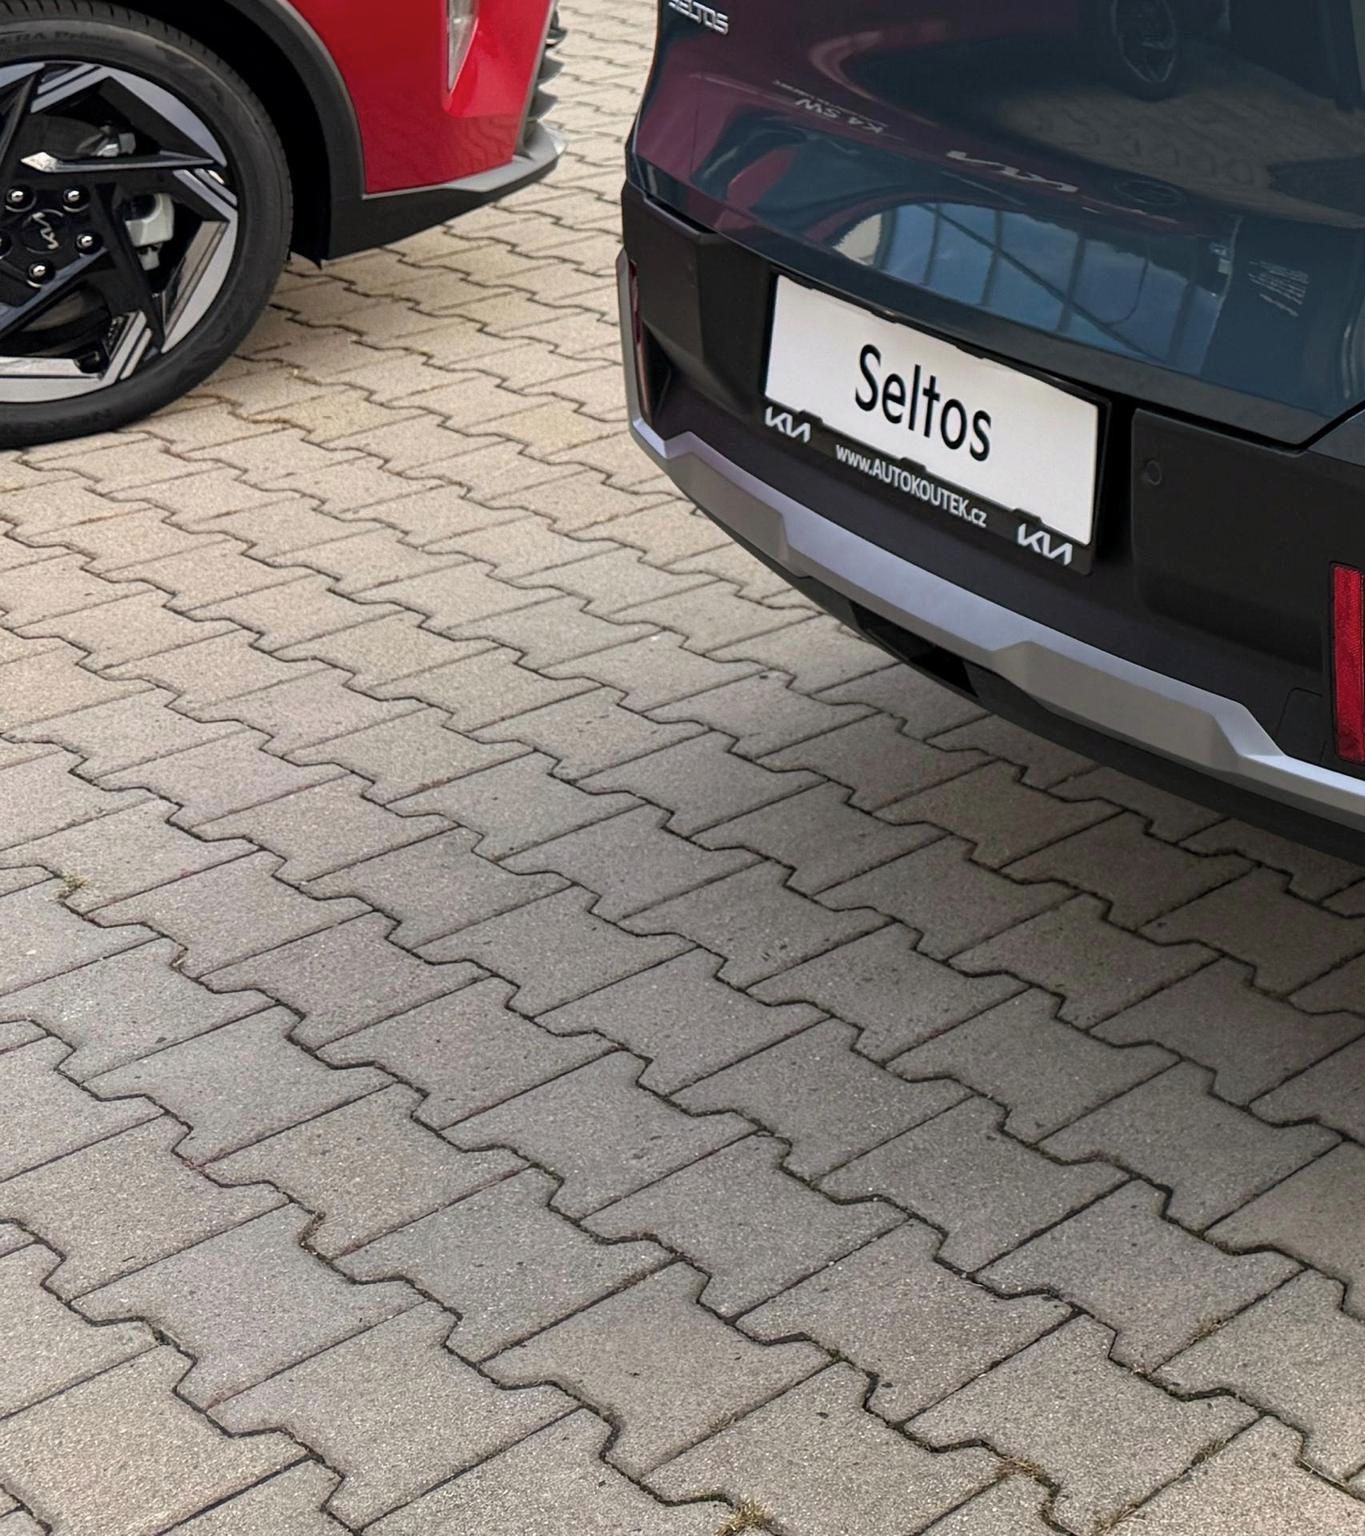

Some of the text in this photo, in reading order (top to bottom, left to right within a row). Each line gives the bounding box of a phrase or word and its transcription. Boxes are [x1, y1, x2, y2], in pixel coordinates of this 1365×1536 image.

[765, 406, 811, 443] KIA
[855, 343, 992, 462] Seltos
[836, 444, 987, 528] www.AUTOKOUTEK.cz
[1017, 523, 1073, 566] KIA
